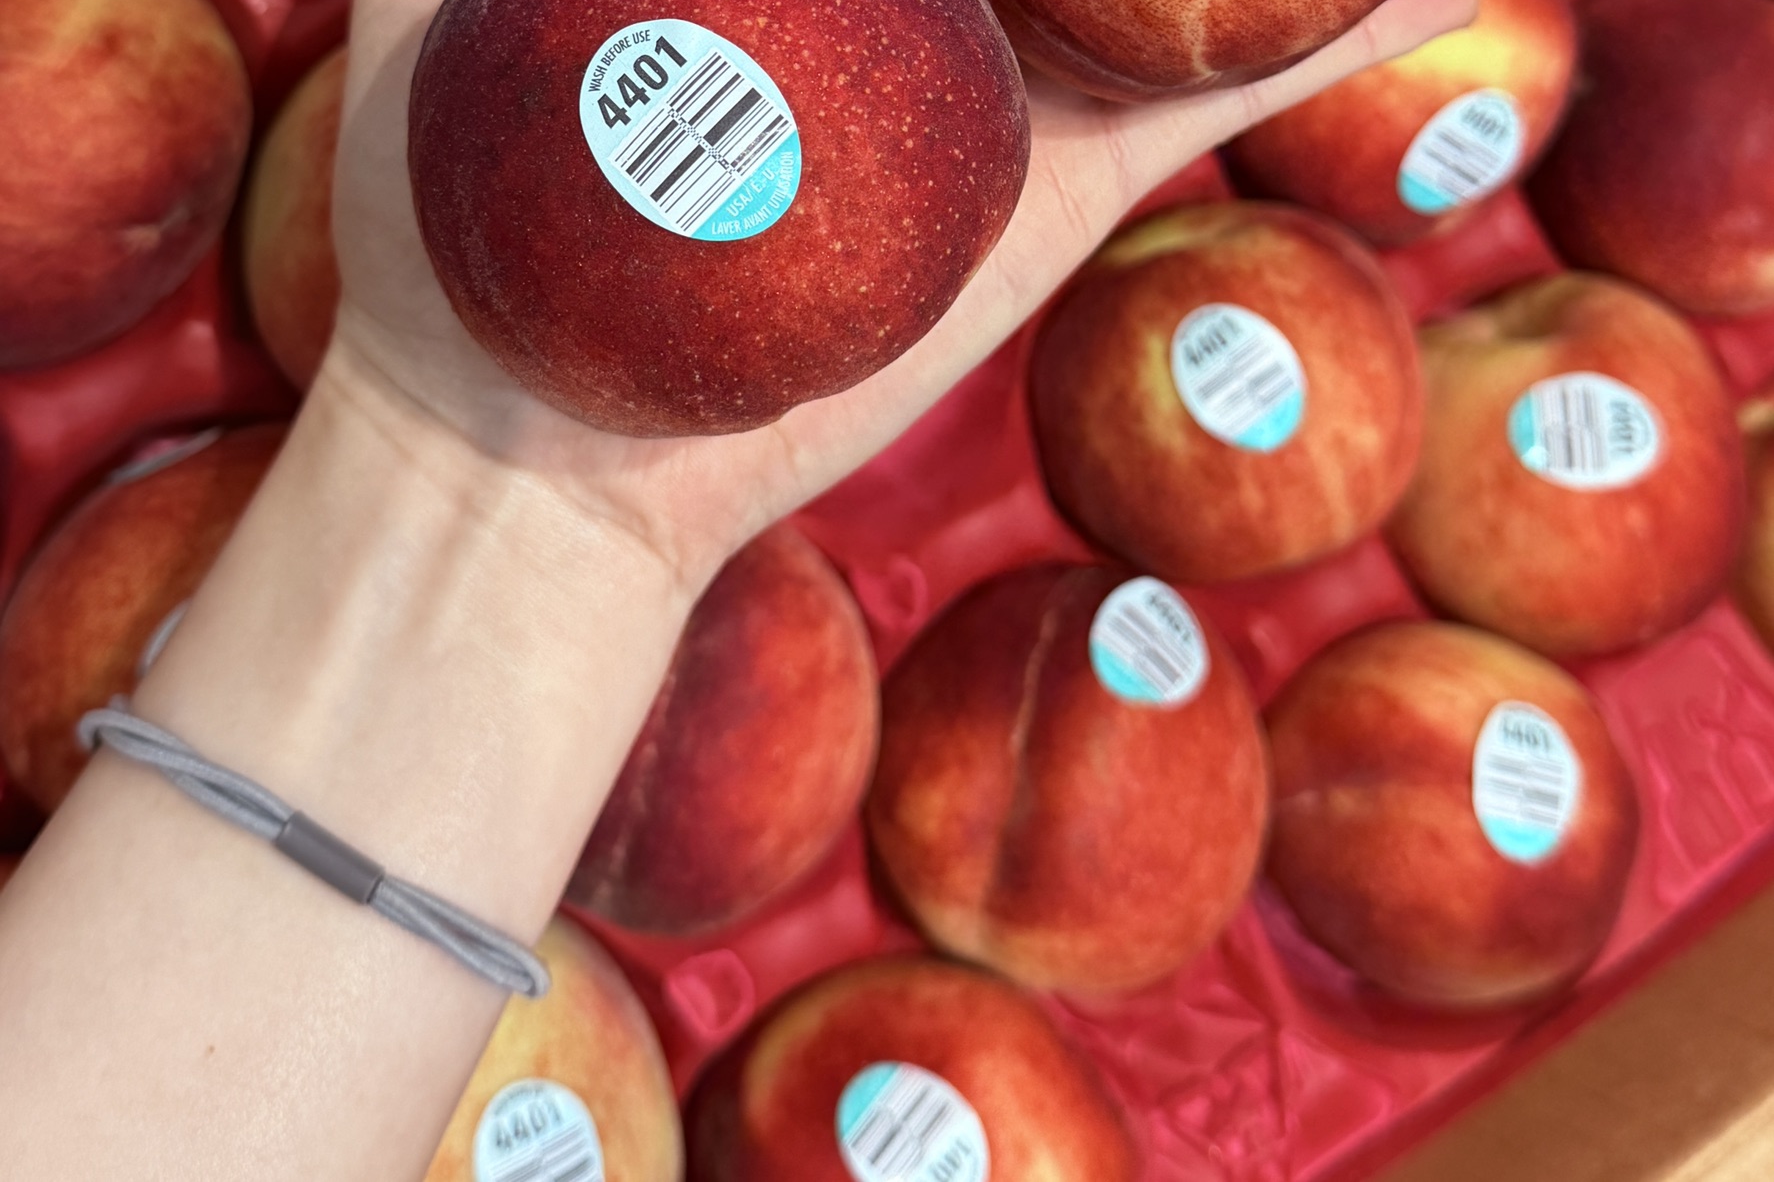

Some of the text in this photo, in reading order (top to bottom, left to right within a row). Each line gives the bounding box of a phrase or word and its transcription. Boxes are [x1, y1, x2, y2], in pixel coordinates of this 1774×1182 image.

[588, 29, 651, 93] WASH BEFORE USE
[597, 35, 687, 129] 4401
[711, 220, 741, 235] LAVER
[743, 204, 772, 230] AVANT
